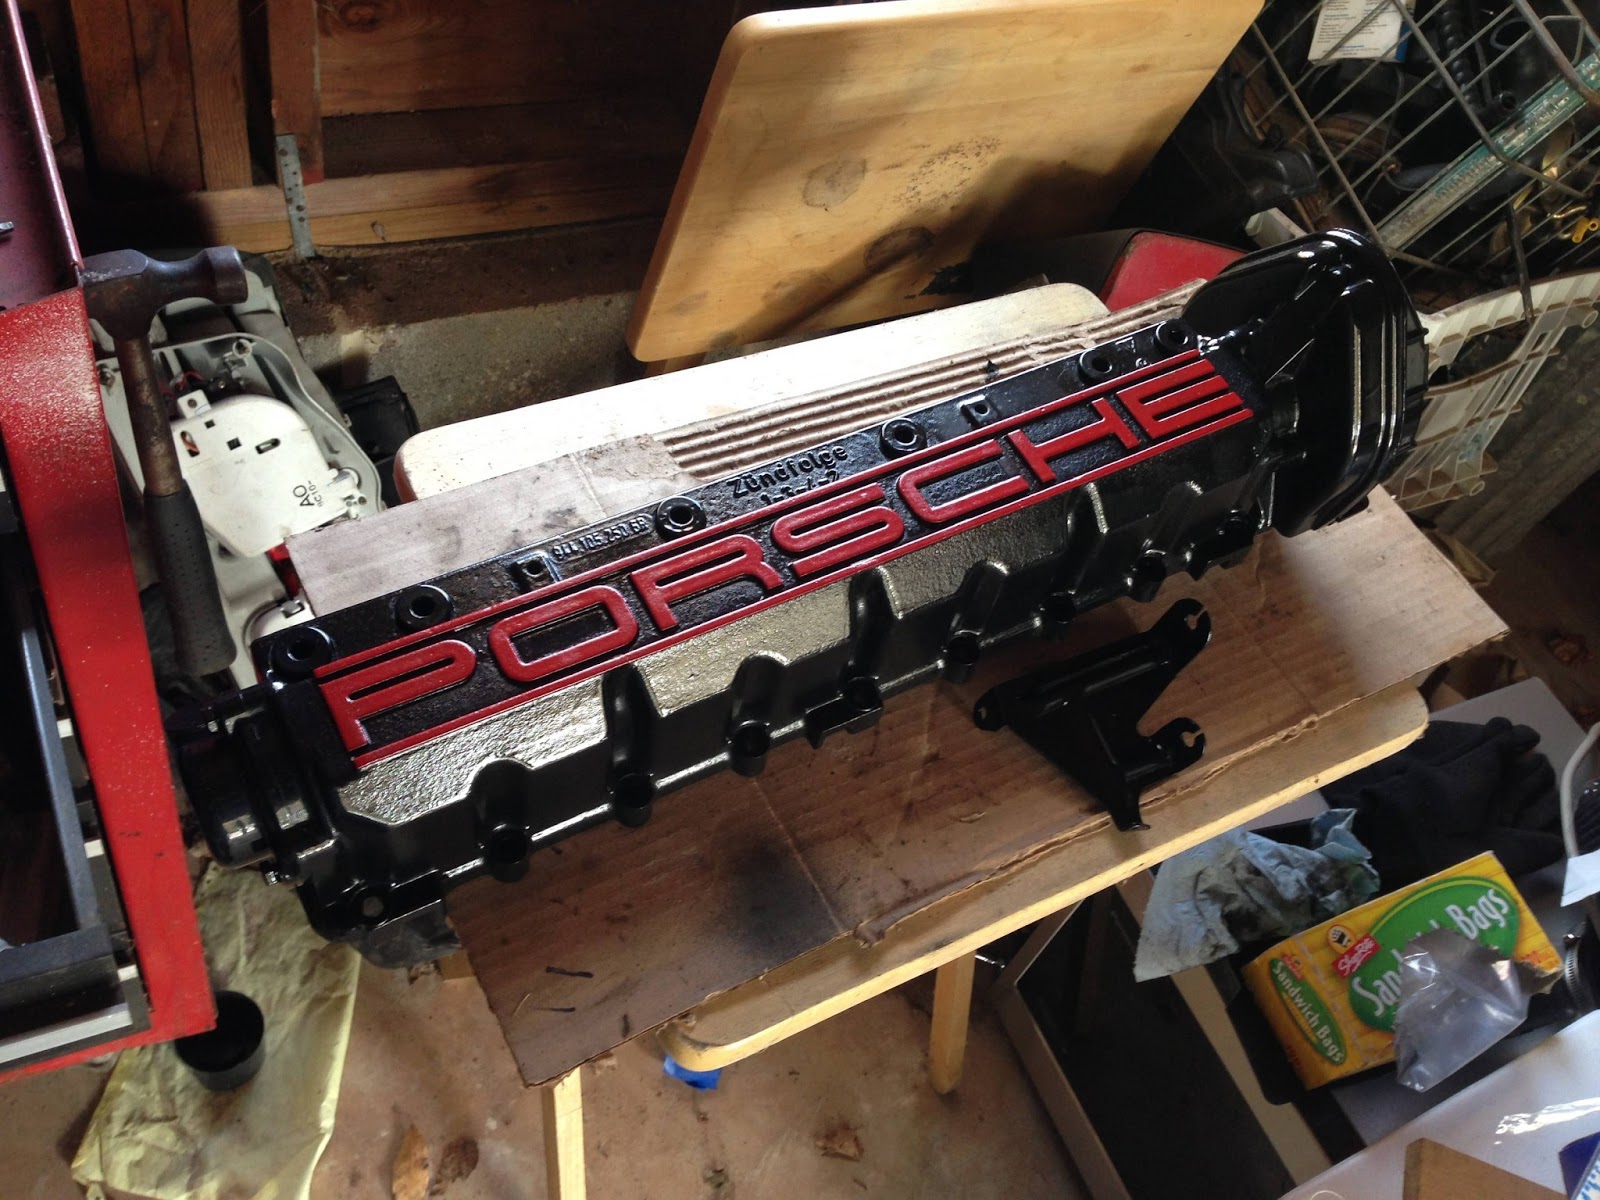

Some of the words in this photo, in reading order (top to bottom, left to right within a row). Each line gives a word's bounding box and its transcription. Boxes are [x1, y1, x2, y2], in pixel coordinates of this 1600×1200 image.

[318, 358, 1245, 752] PORSCHE
[1445, 889, 1509, 940] Bags
[1272, 960, 1320, 1028] Sandwich
[1316, 1025, 1344, 1063] Bags
